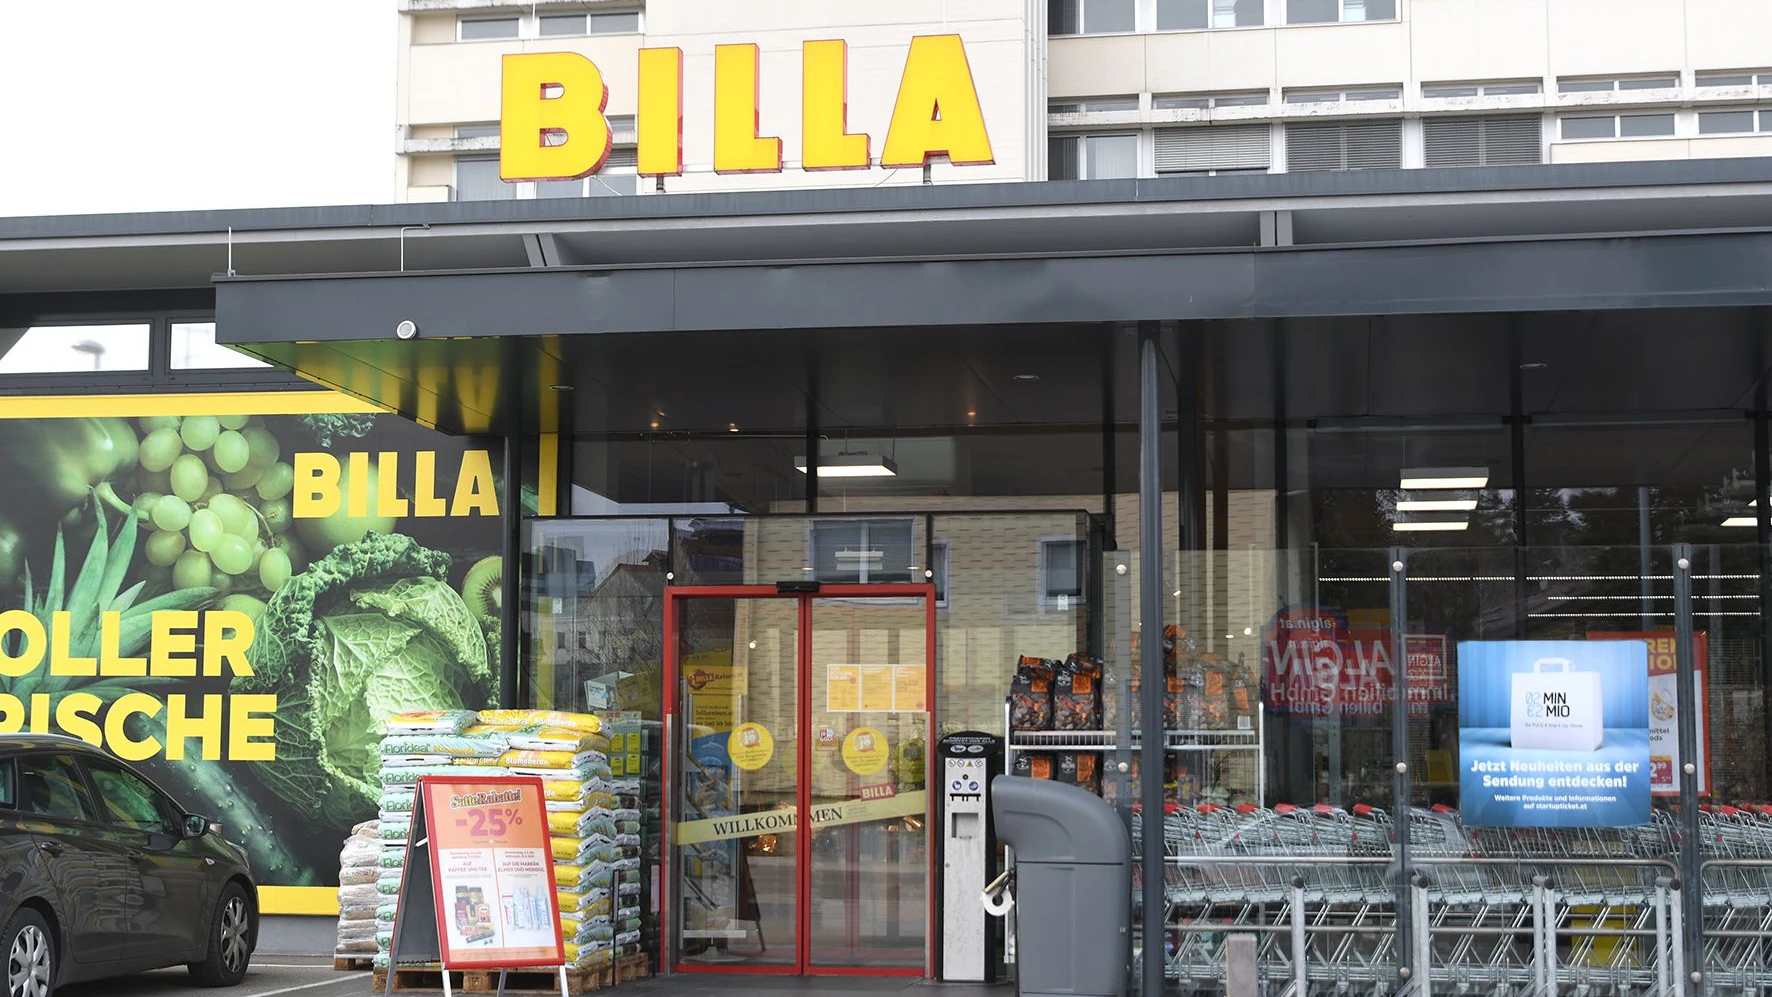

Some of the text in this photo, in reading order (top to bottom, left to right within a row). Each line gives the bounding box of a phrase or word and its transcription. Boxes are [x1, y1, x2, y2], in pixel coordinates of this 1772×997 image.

[500, 34, 996, 183] BILLA
[293, 450, 500, 518] BILLA
[0, 609, 256, 677] OLLER
[1543, 692, 1567, 705] MIN
[1546, 704, 1571, 718] MIO
[384, 742, 430, 754] Florideal
[1471, 760, 1639, 773] Jetzt Neuheiten aus der
[1482, 774, 1628, 788] Sendung entdecken!
[862, 785, 894, 799] BILLA
[1494, 794, 1617, 802] Weitere Produkte und Informationen
[1535, 803, 1588, 811] startupticket.at
[455, 808, 523, 837] -25%
